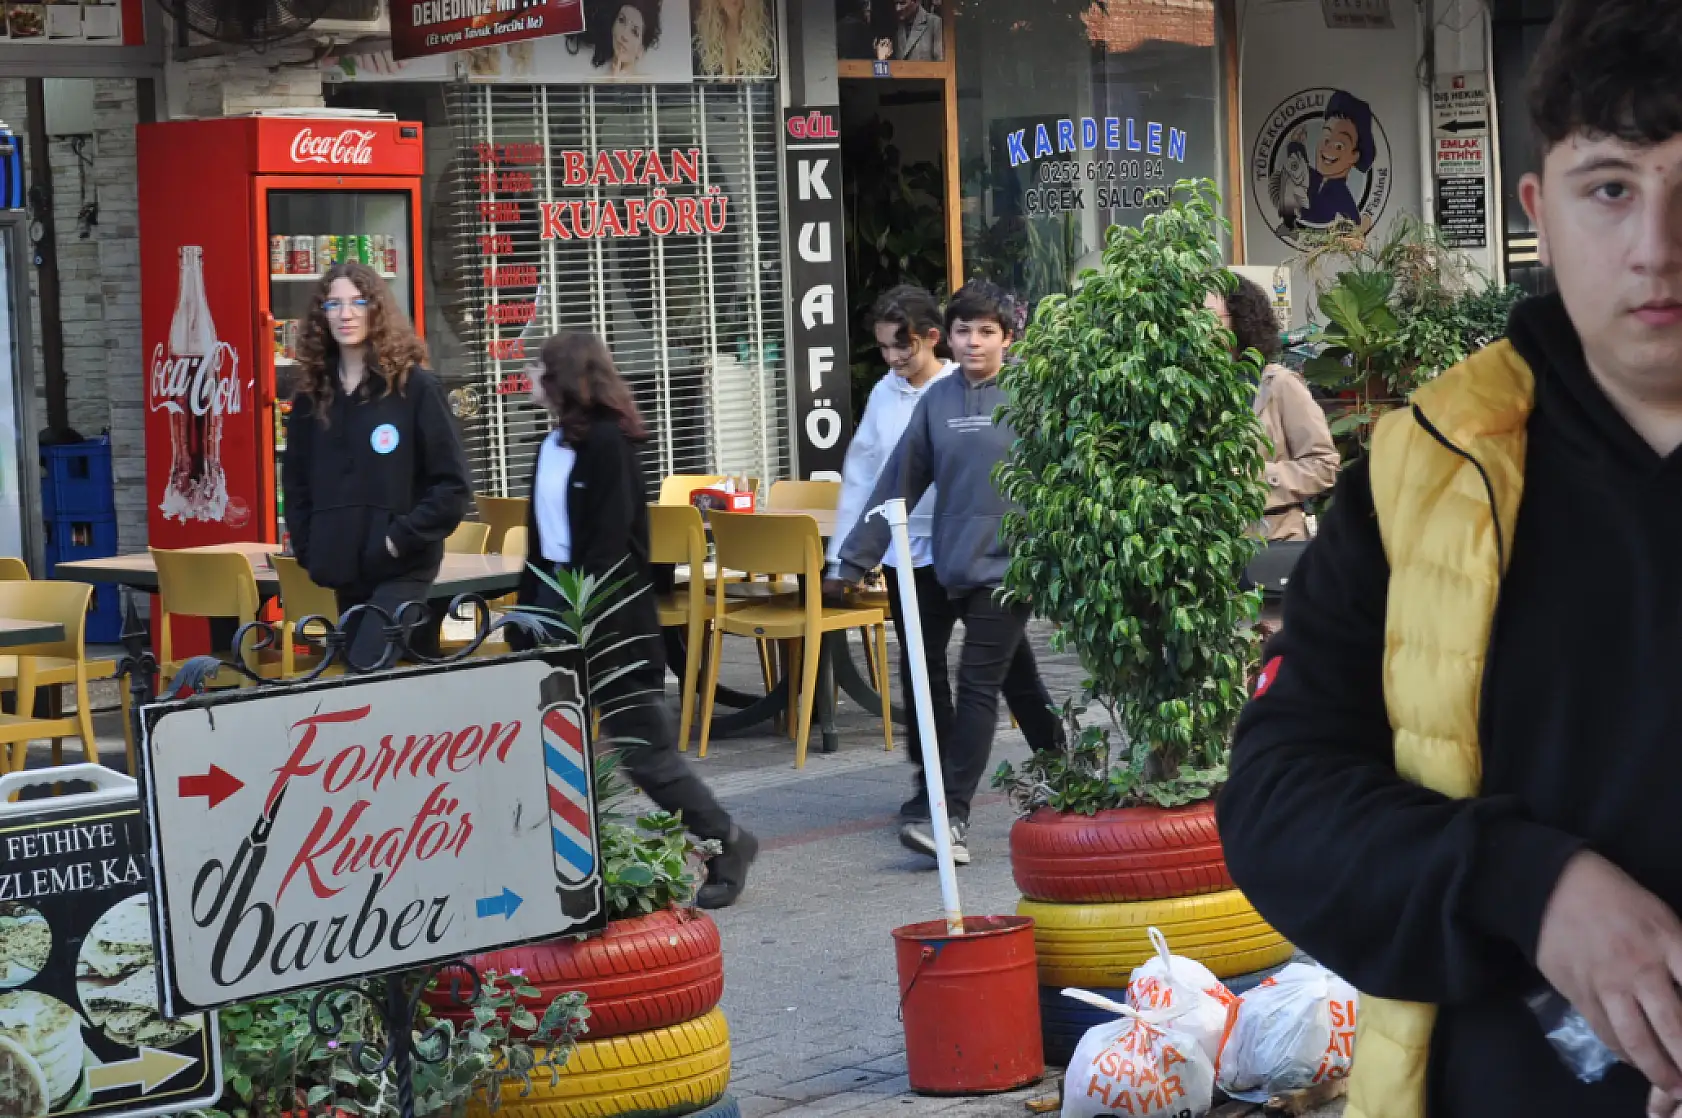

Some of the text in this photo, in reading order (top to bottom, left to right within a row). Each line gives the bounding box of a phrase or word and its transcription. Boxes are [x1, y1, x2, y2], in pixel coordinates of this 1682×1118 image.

[464, 26, 491, 40] Tavuk
[787, 111, 839, 138] GÜL
[1007, 117, 1187, 166] KARDELEN
[290, 127, 377, 164] Coca-Cola
[1437, 148, 1482, 160] FETHİYE
[1440, 139, 1479, 148] EMLAK
[561, 148, 699, 186] BAYAN
[1040, 158, 1165, 183] 0252 612 90 94
[540, 186, 727, 239] KUAFÖRÜ
[1025, 182, 1085, 218] ÇİÇEK
[798, 158, 843, 483] KUAFÖ
[264, 704, 521, 818] Formen
[6, 823, 116, 860] FETHİYE
[275, 782, 473, 908] Kuaför
[100, 853, 146, 886] KA
[209, 846, 455, 987] barber
[1087, 1074, 1186, 1117] HAYIR
